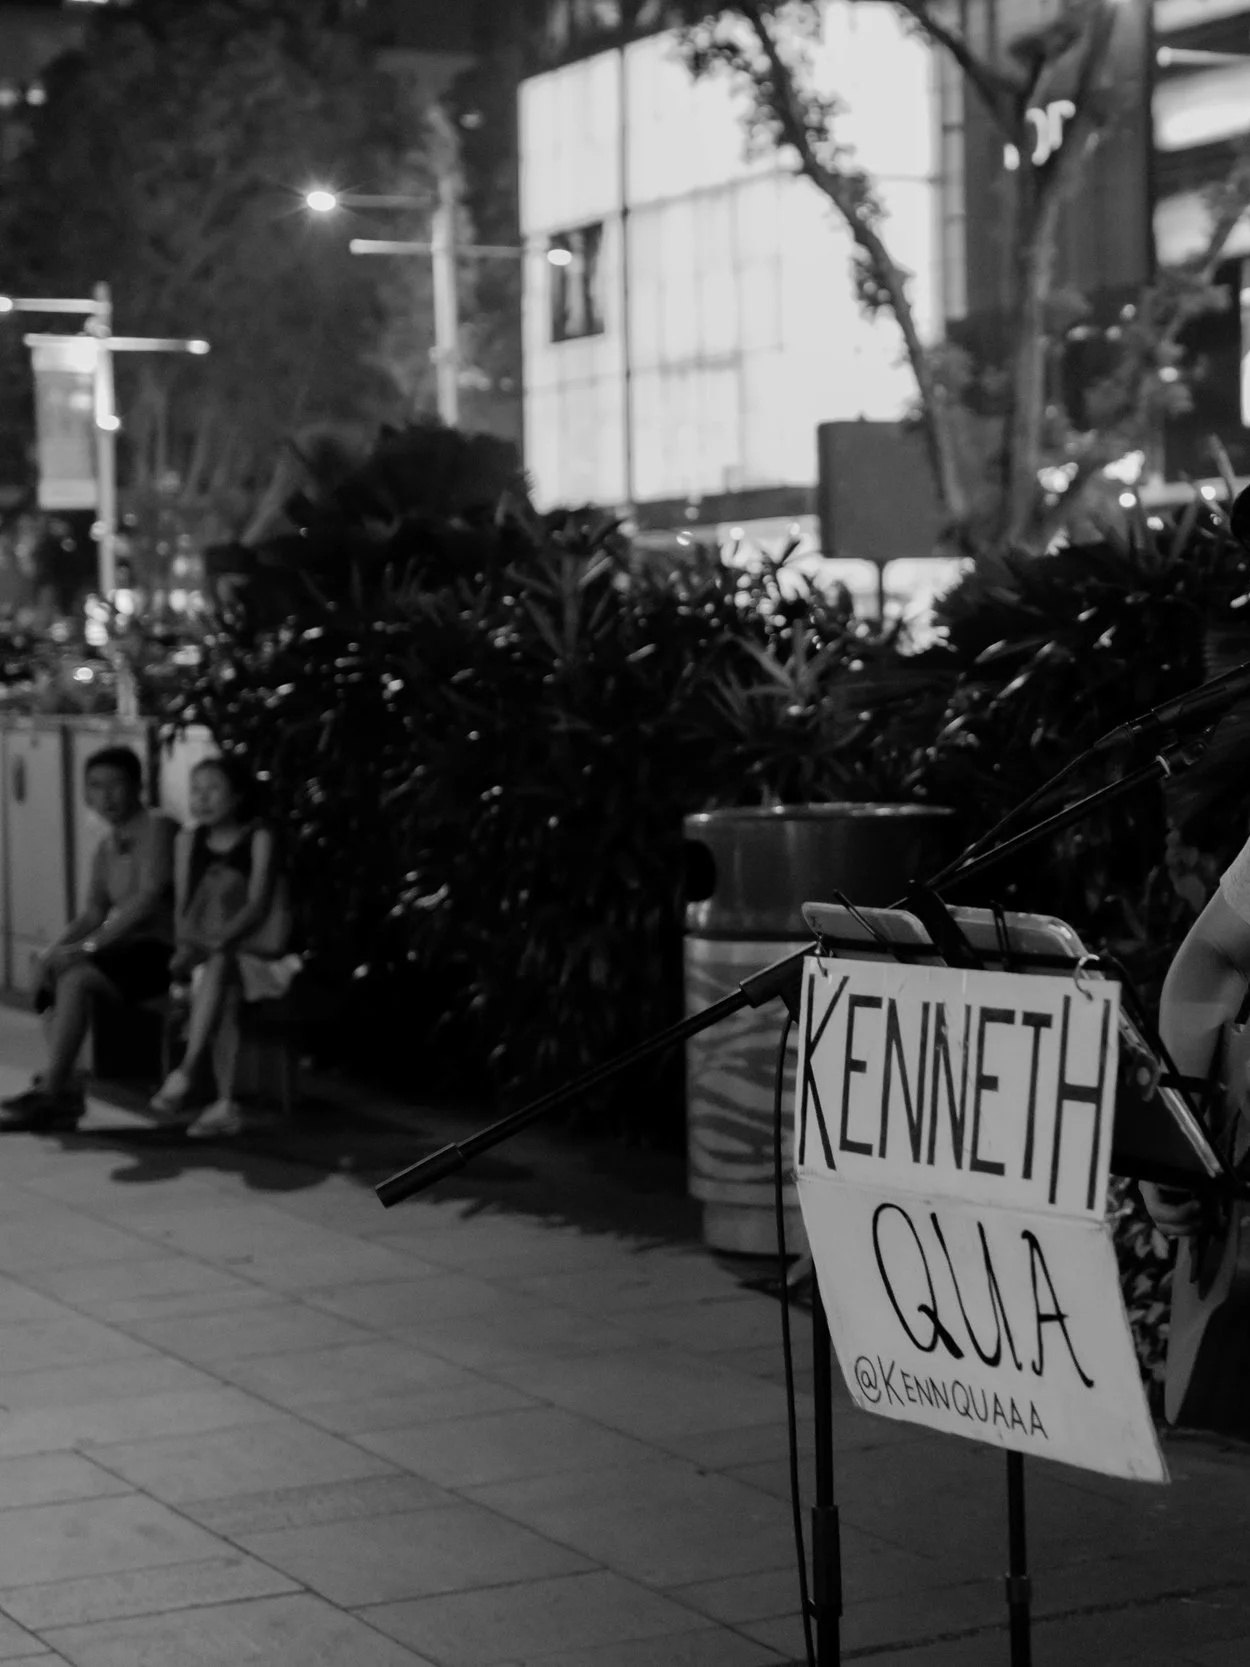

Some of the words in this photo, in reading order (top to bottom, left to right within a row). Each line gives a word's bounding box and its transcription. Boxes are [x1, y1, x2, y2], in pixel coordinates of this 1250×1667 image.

[799, 974, 1111, 1210] KENNETH
[872, 1202, 1095, 1389] QUA
[854, 1355, 1048, 1439] @KENNQUAAA
